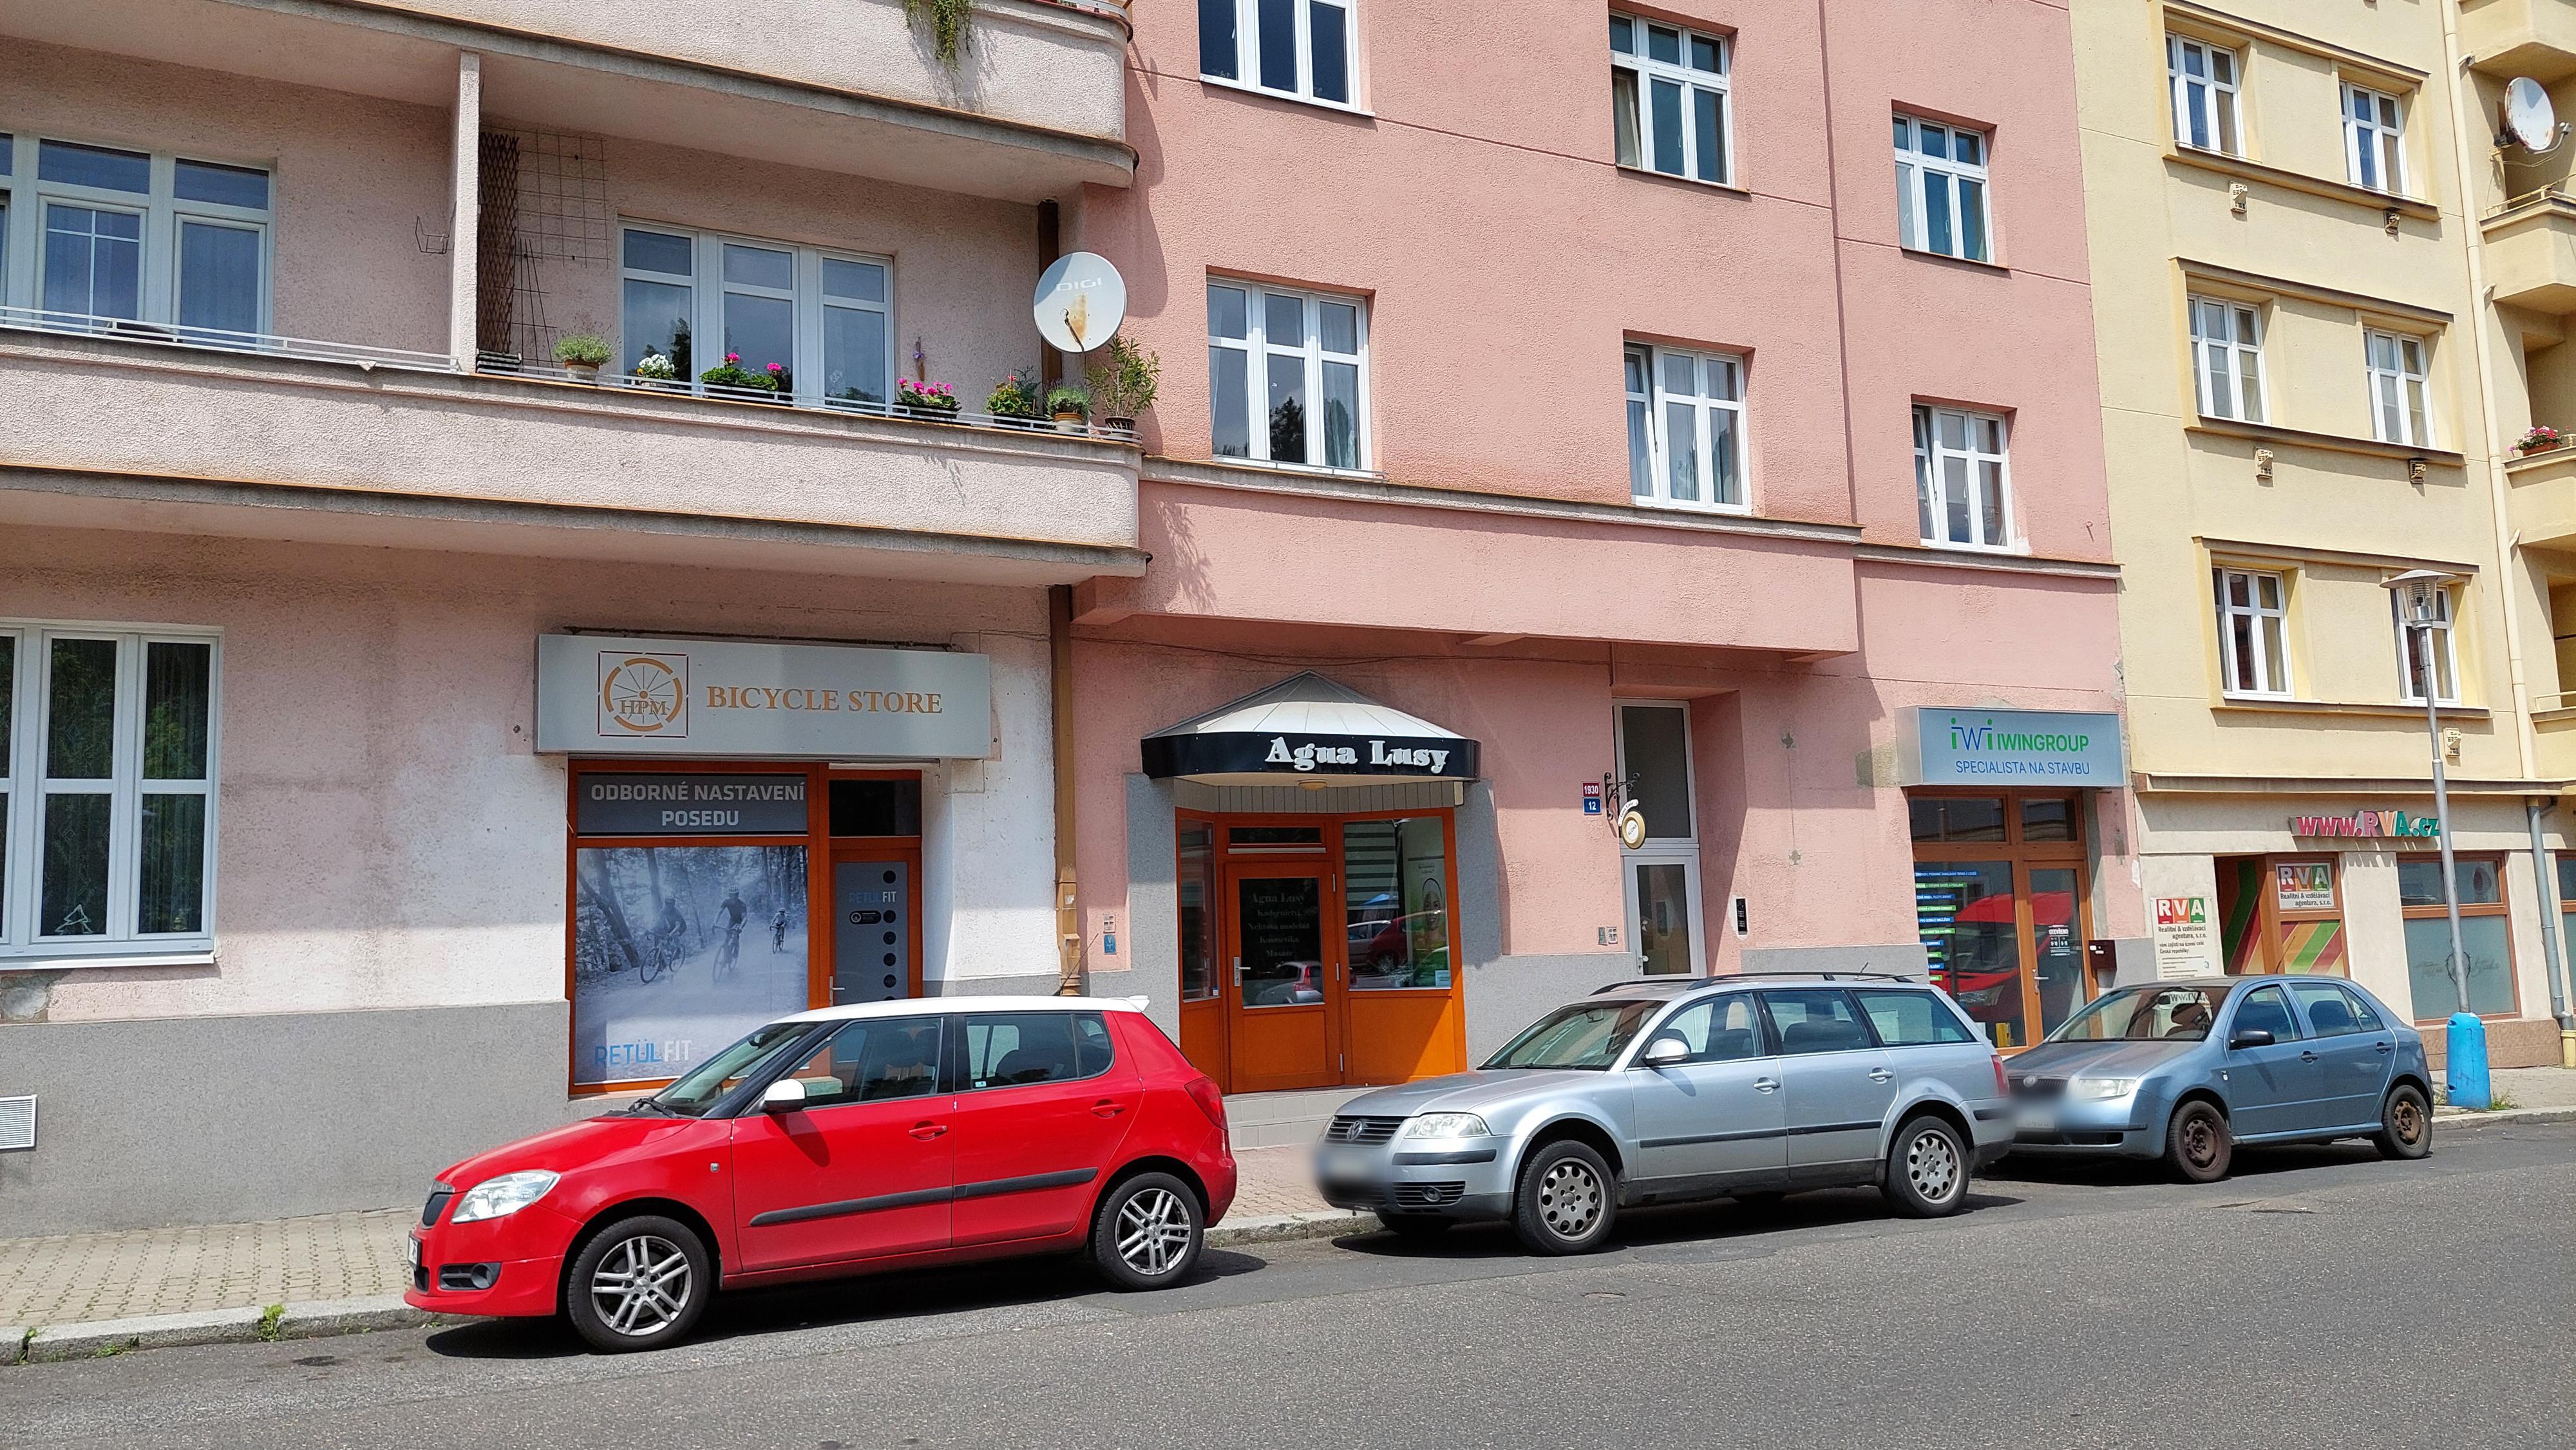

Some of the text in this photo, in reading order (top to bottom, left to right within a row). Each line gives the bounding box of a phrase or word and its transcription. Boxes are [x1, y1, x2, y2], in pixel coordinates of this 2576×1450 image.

[1056, 278, 1102, 292] DIGI
[620, 700, 668, 715] HPM
[706, 686, 943, 713] BICYCLE STORE
[1997, 733, 2089, 751] IWINGROUP
[1265, 737, 1450, 773] Agua Lusy
[1956, 760, 2090, 775] SPECIALISTA NA STAVBU
[591, 781, 805, 800] ODBORNÉ NASTAVENÍ
[1584, 785, 1598, 795] 1930
[1588, 801, 1596, 810] 12
[662, 810, 739, 826] POSEDU
[2280, 867, 2328, 885] RVA
[882, 891, 896, 902] FIT
[2158, 899, 2204, 916] RVA
[594, 1039, 692, 1068] RETÜL FIT
